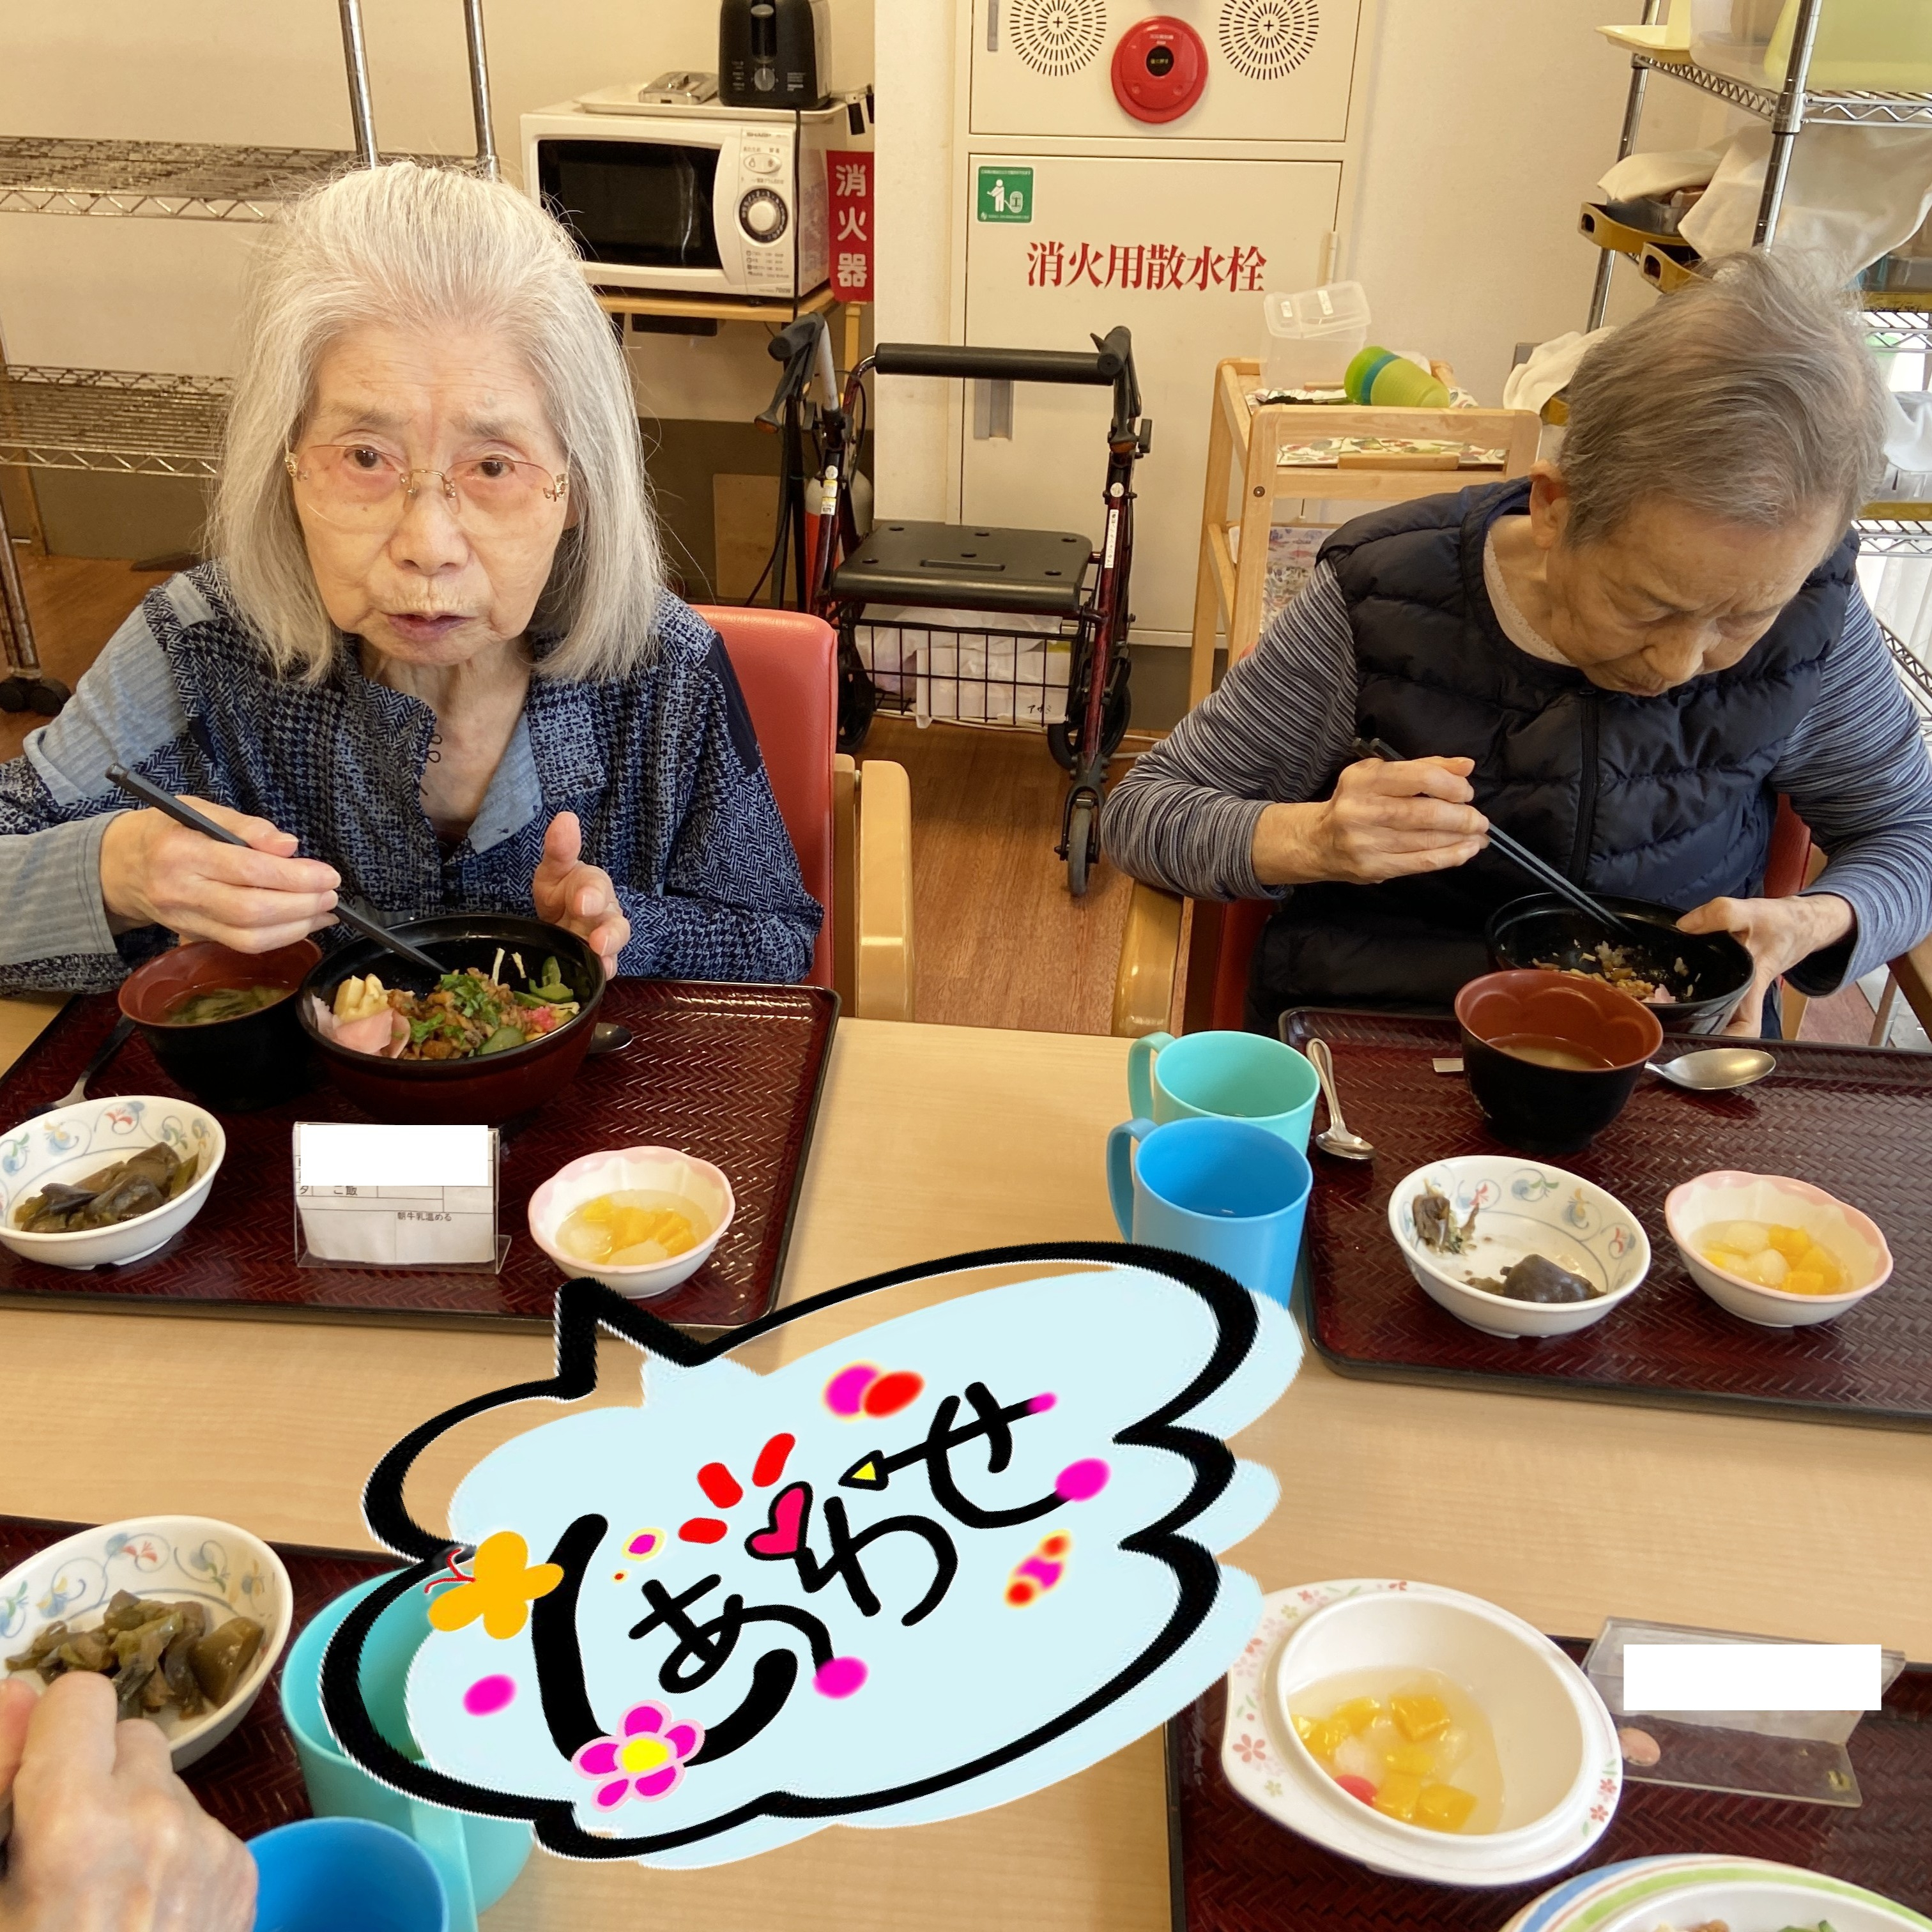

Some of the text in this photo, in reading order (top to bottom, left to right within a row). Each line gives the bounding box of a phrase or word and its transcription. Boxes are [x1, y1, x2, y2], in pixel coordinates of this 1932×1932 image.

[836, 164, 868, 288] 消火器
[1026, 240, 1268, 293] 消火用散水栓
